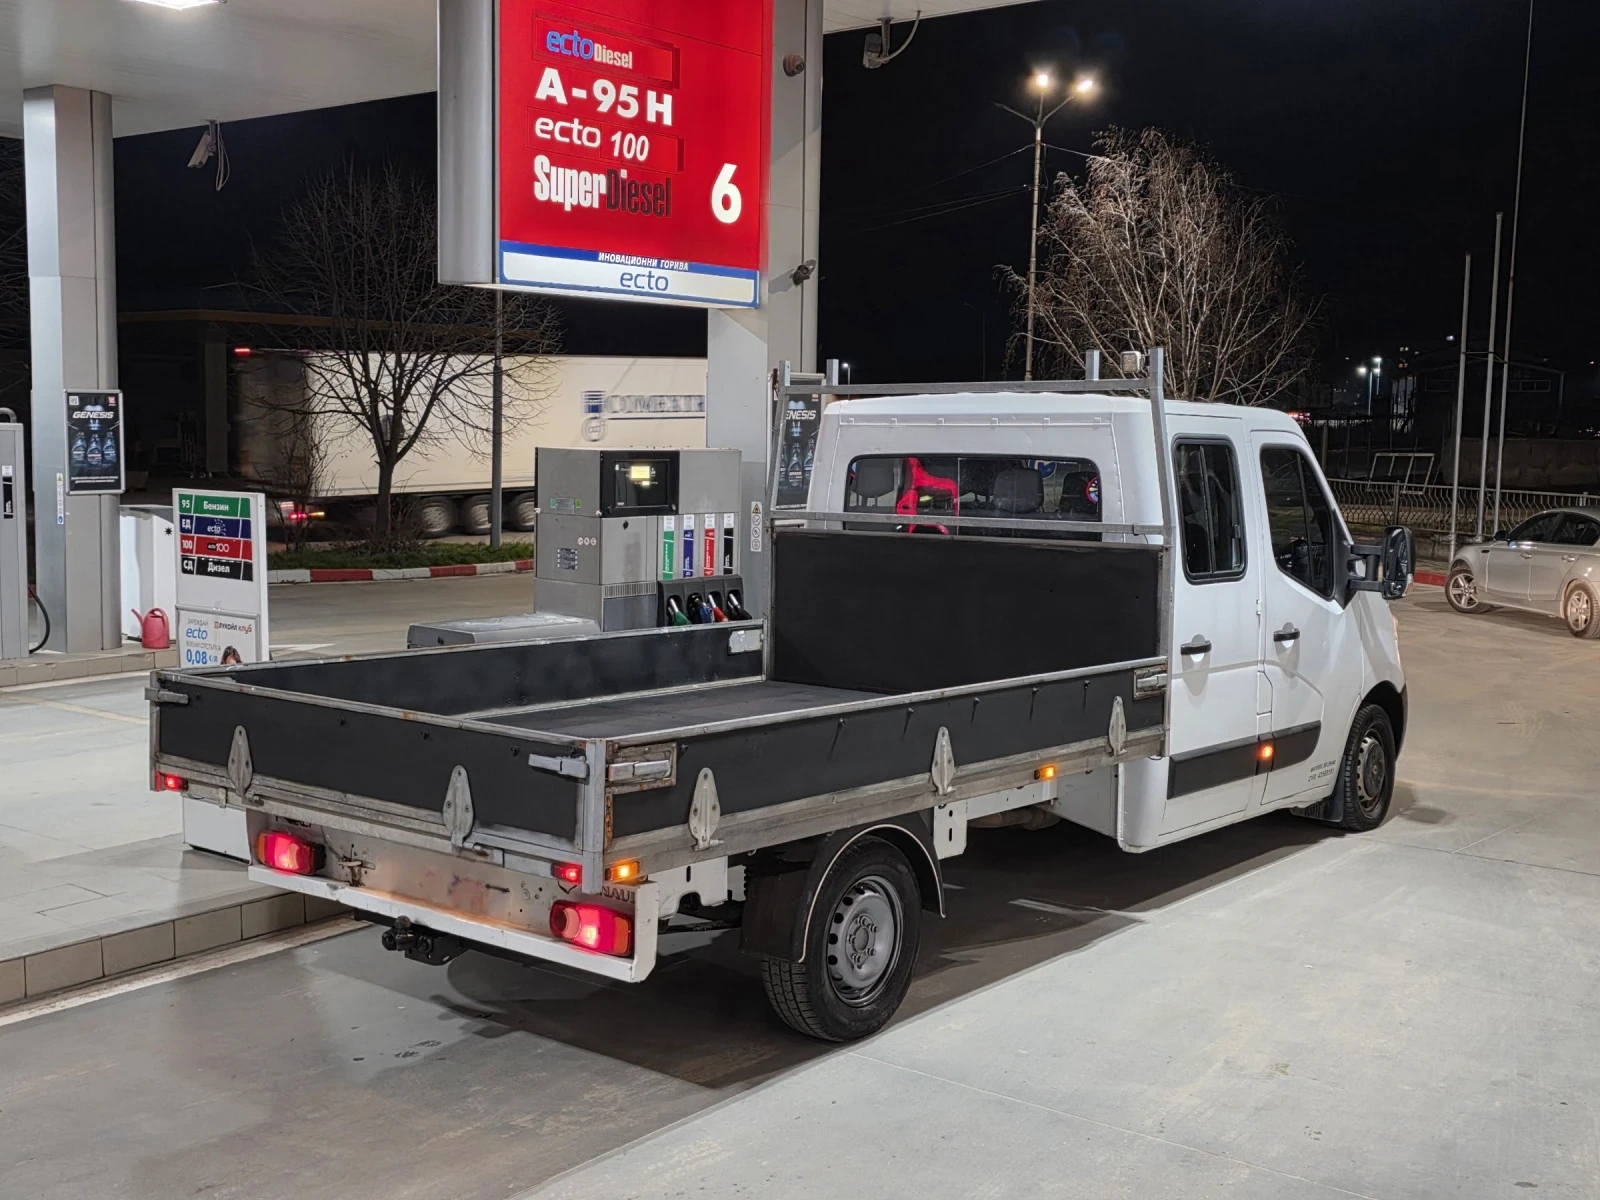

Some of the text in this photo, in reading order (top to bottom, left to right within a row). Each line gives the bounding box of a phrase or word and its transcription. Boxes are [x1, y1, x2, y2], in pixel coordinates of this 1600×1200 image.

[535, 116, 650, 162] ecto 100
[710, 163, 742, 224] 6
[598, 252, 689, 272] ИНОВАЦИОННИ ГОРИВА
[619, 270, 669, 293] ecto
[72, 411, 114, 419] GENESIS
[786, 410, 817, 420] ENESIS
[181, 499, 229, 511] 95 Бензин
[181, 519, 221, 533] ЕД ecto
[182, 539, 193, 550] 100
[215, 543, 230, 553] 100
[183, 560, 230, 573] СД Дизел
[186, 627, 208, 640] ecto
[186, 648, 208, 665] 0,08
